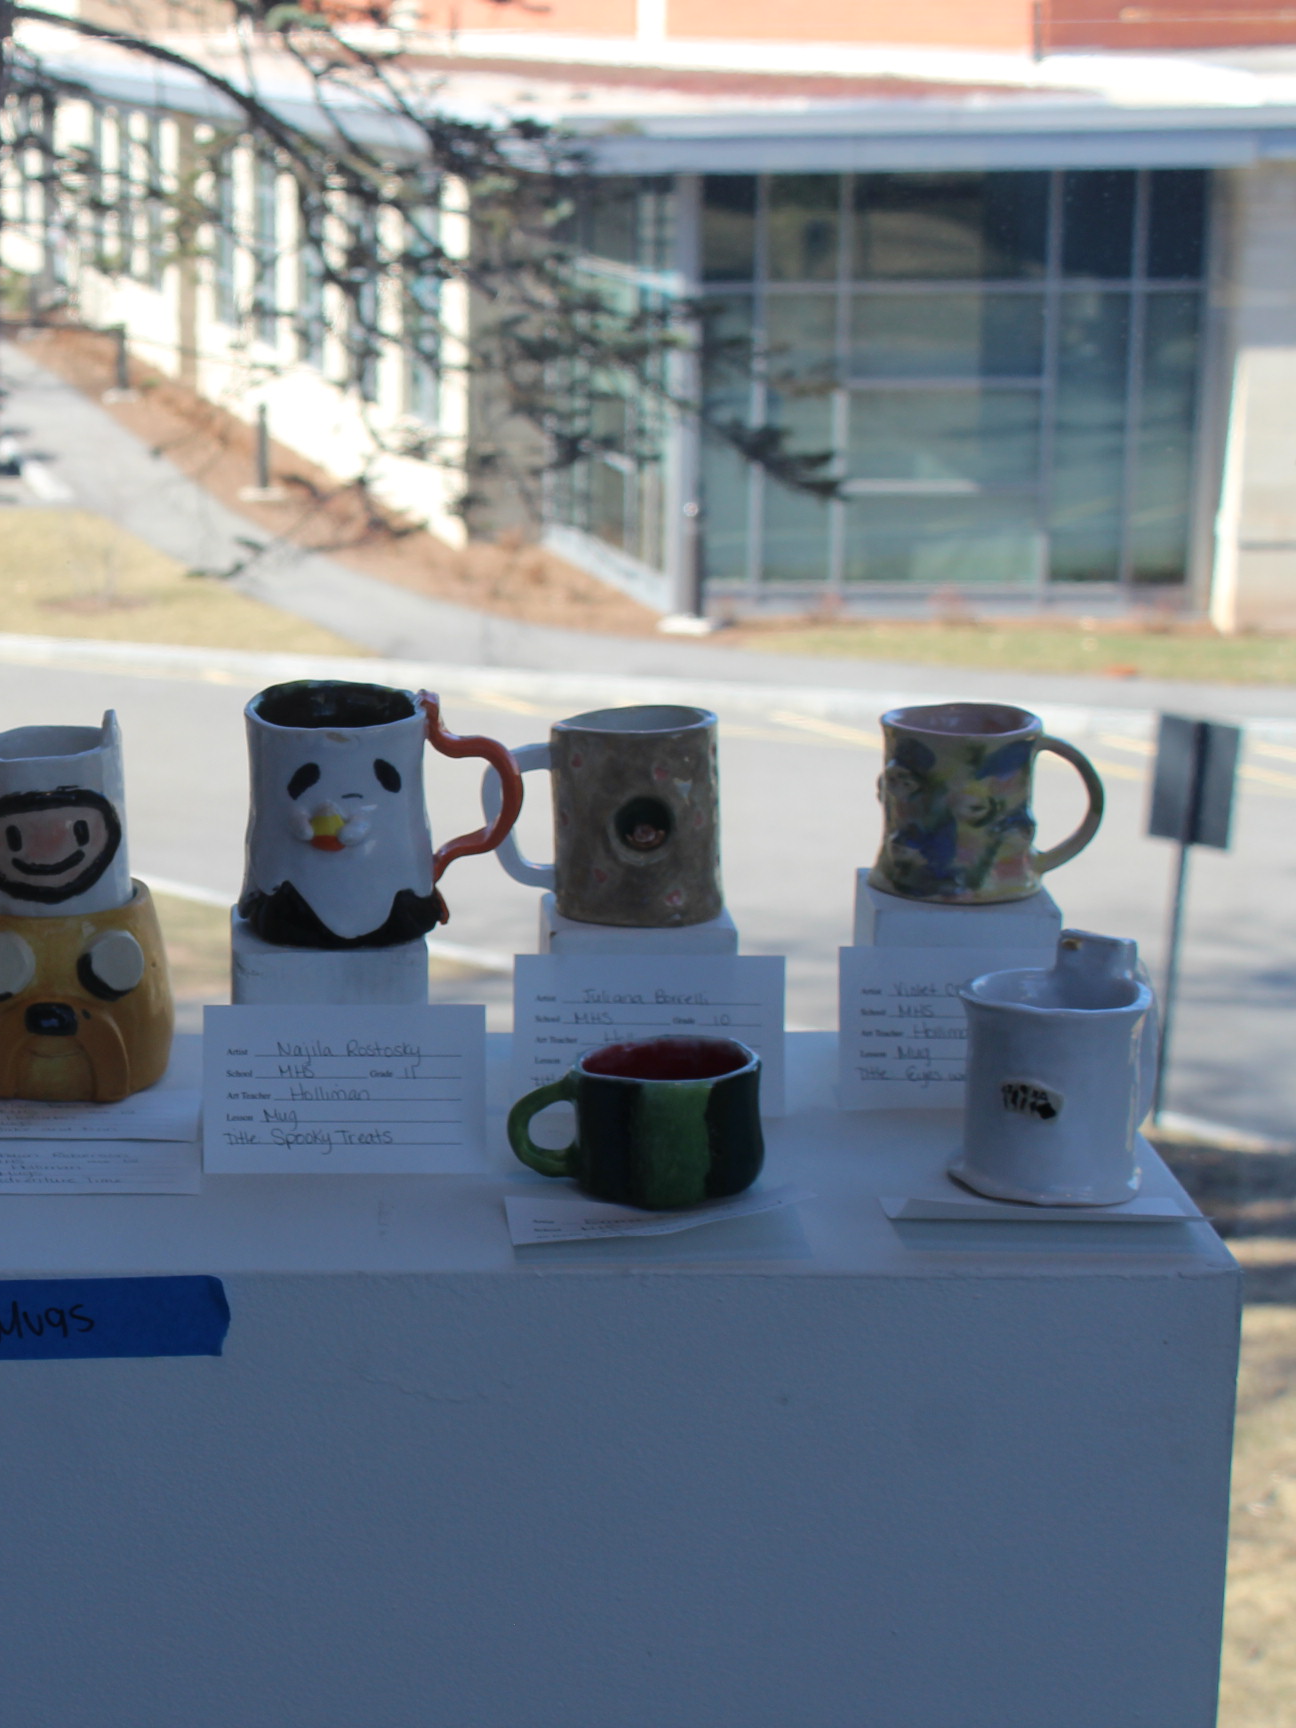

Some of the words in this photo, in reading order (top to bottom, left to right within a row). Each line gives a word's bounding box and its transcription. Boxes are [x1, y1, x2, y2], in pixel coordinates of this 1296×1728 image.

[581, 987, 645, 1005] Juliana
[573, 1011, 615, 1026] MHS
[713, 1012, 732, 1027] 10
[897, 1003, 935, 1018] MHS
[225, 1047, 249, 1057] Artist
[275, 1040, 335, 1067] Najila
[345, 1038, 421, 1067] Rostosky
[896, 1045, 931, 1068] Mug
[225, 1069, 254, 1079] School
[277, 1063, 316, 1080] MHS
[368, 1069, 394, 1079] Grade
[403, 1065, 417, 1081] 11
[225, 1091, 241, 1101] Art
[242, 1091, 272, 1101] Teacher
[288, 1081, 371, 1103] Holliman
[225, 1112, 254, 1122] Lesson
[261, 1107, 299, 1132] Mug
[269, 1127, 334, 1156] Spooky
[333, 1128, 394, 1147] Treats
